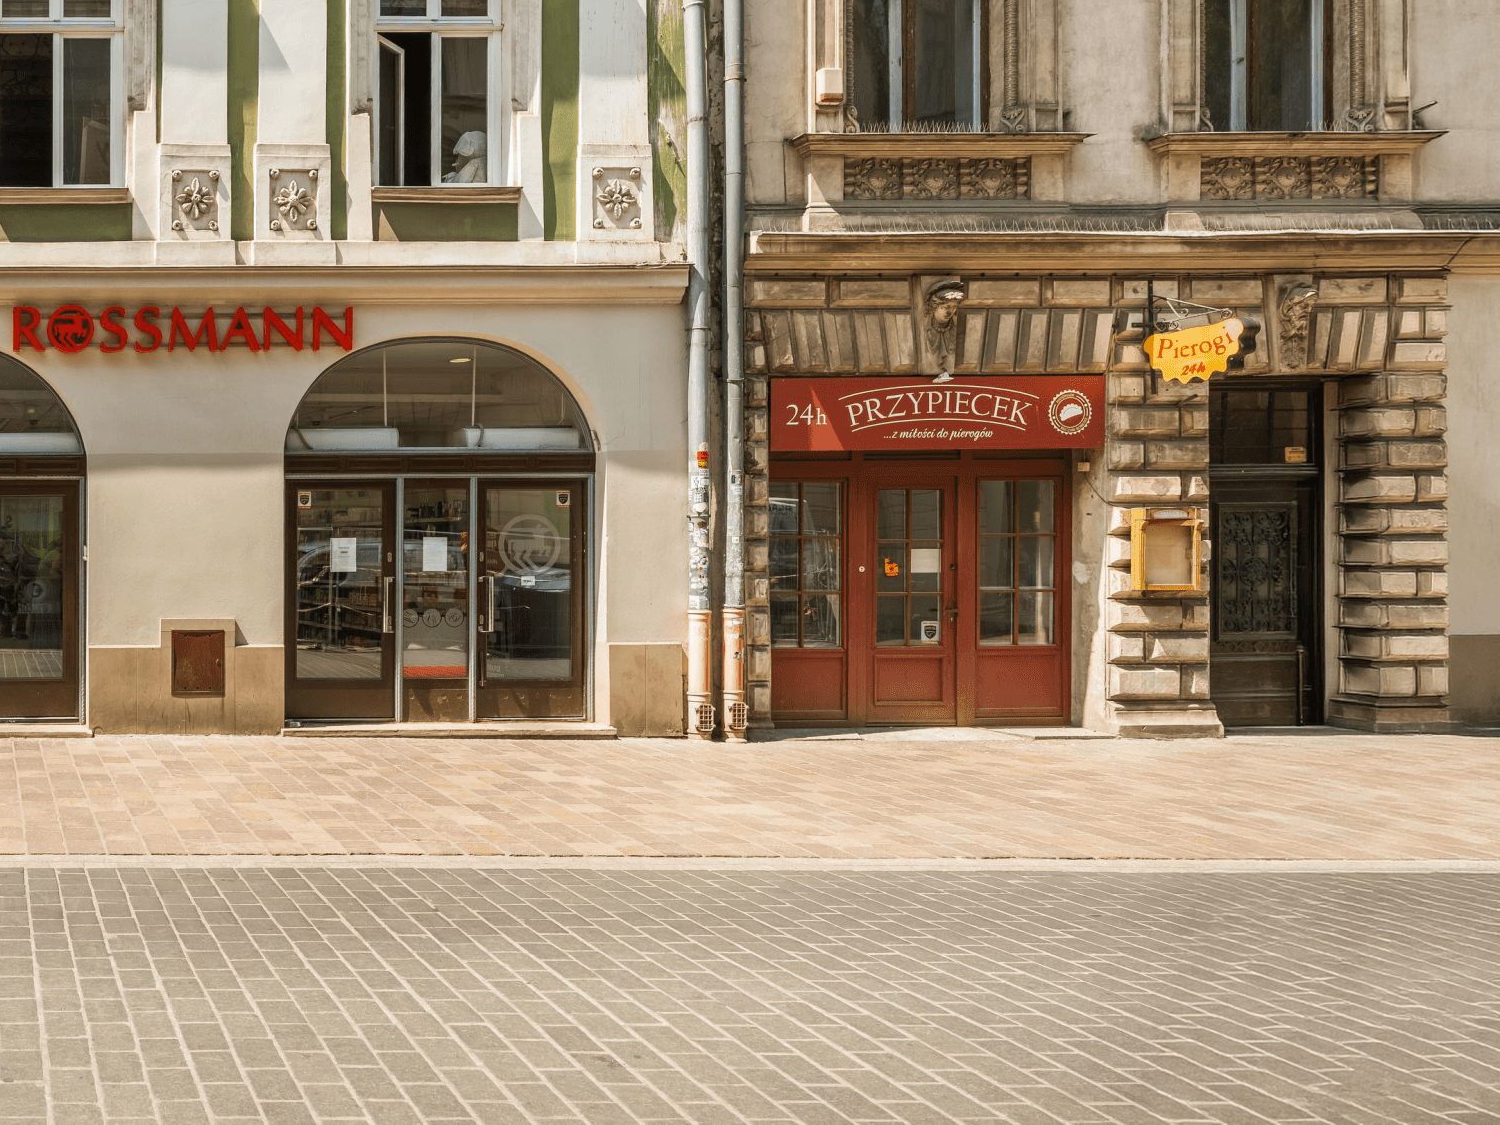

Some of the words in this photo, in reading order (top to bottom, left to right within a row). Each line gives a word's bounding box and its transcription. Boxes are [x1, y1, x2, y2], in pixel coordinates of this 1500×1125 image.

[12, 304, 354, 354] ROSSMANN
[1156, 332, 1234, 359] Pierogi
[1181, 362, 1206, 376] 24h
[786, 403, 827, 425] 24h
[845, 390, 1033, 426] PRZYPIECEK
[899, 427, 936, 439] miłości
[936, 426, 949, 439] do
[949, 426, 994, 442] pierogów
